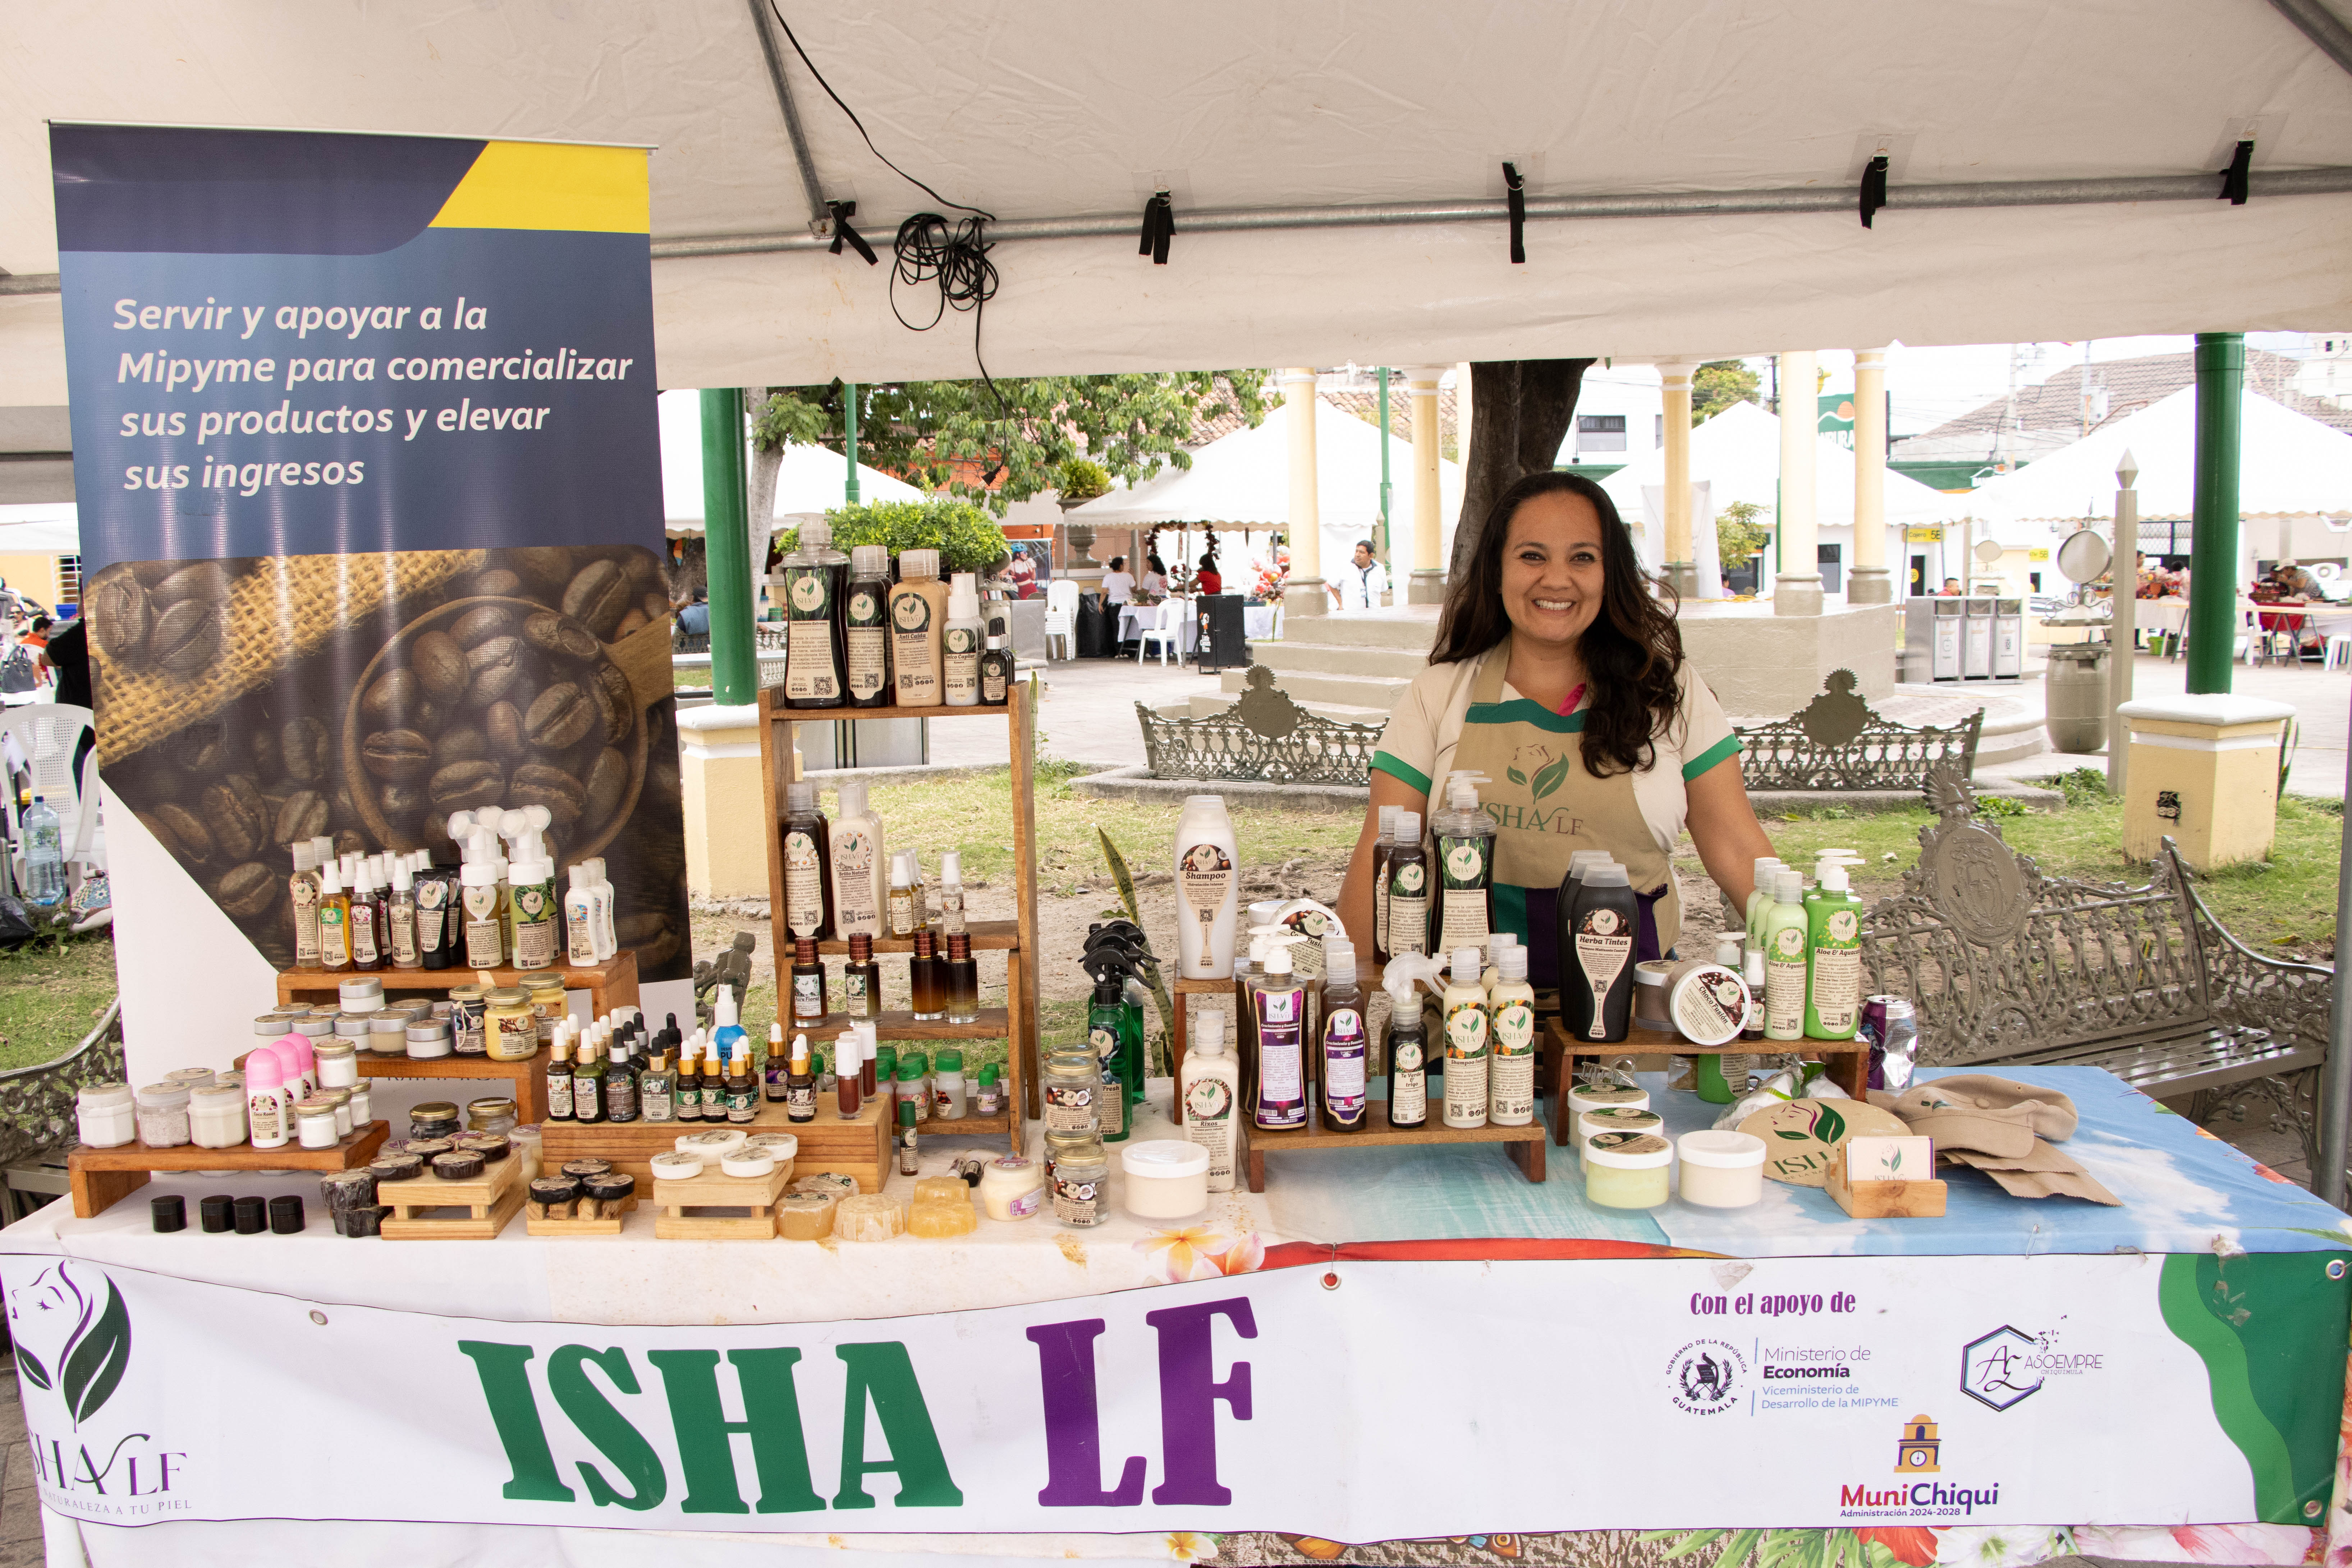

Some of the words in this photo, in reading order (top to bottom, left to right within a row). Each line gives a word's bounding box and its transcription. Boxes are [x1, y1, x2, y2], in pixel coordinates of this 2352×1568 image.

[114, 297, 231, 330] Servir
[242, 306, 265, 339] y
[275, 304, 410, 339] apoyar
[420, 308, 443, 329] a
[455, 297, 486, 330] la
[118, 350, 274, 393] Mipyme
[287, 357, 376, 390] para
[388, 348, 633, 381] comercializar
[120, 409, 185, 437] sus
[197, 400, 393, 444] productos
[404, 408, 427, 440] y
[437, 398, 549, 431] elevar
[124, 463, 189, 490] sus
[202, 456, 364, 496] ingresos
[1186, 872, 1225, 881] Shampoo
[1699, 986, 1714, 1005] Choco
[1712, 1003, 1728, 1023] Fusión
[1772, 1151, 1829, 1175] ISH
[1690, 1293, 1727, 1315] Con
[1734, 1293, 1753, 1315] el
[1760, 1291, 1824, 1317] apoyo
[1830, 1291, 1856, 1314] de
[1666, 1343, 1693, 1375] GOBIERNO
[1720, 1342, 1747, 1374] REPÚBLICA
[1765, 1346, 1846, 1361] Ministerio
[1850, 1345, 1870, 1361] de
[2024, 1354, 2104, 1369] ASOEMPRE
[1764, 1363, 1850, 1379] Economía
[1762, 1385, 1842, 1395] Viceministerio
[1846, 1384, 1859, 1394] de
[458, 1339, 964, 1514] ISHA
[1026, 1296, 1259, 1507] LF
[1672, 1397, 1738, 1415] GUATEMALA
[1762, 1398, 1818, 1409] Desarrollo
[1822, 1398, 1835, 1407] de
[1839, 1398, 1848, 1407] la
[1851, 1398, 1898, 1407] MIPYME
[127, 1453, 187, 1496] LF
[44, 1490, 110, 1514] NATURALEZA
[130, 1505, 149, 1515] TU
[159, 1500, 192, 1511] PIEL
[1840, 1482, 1999, 1515] MuniChiqui
